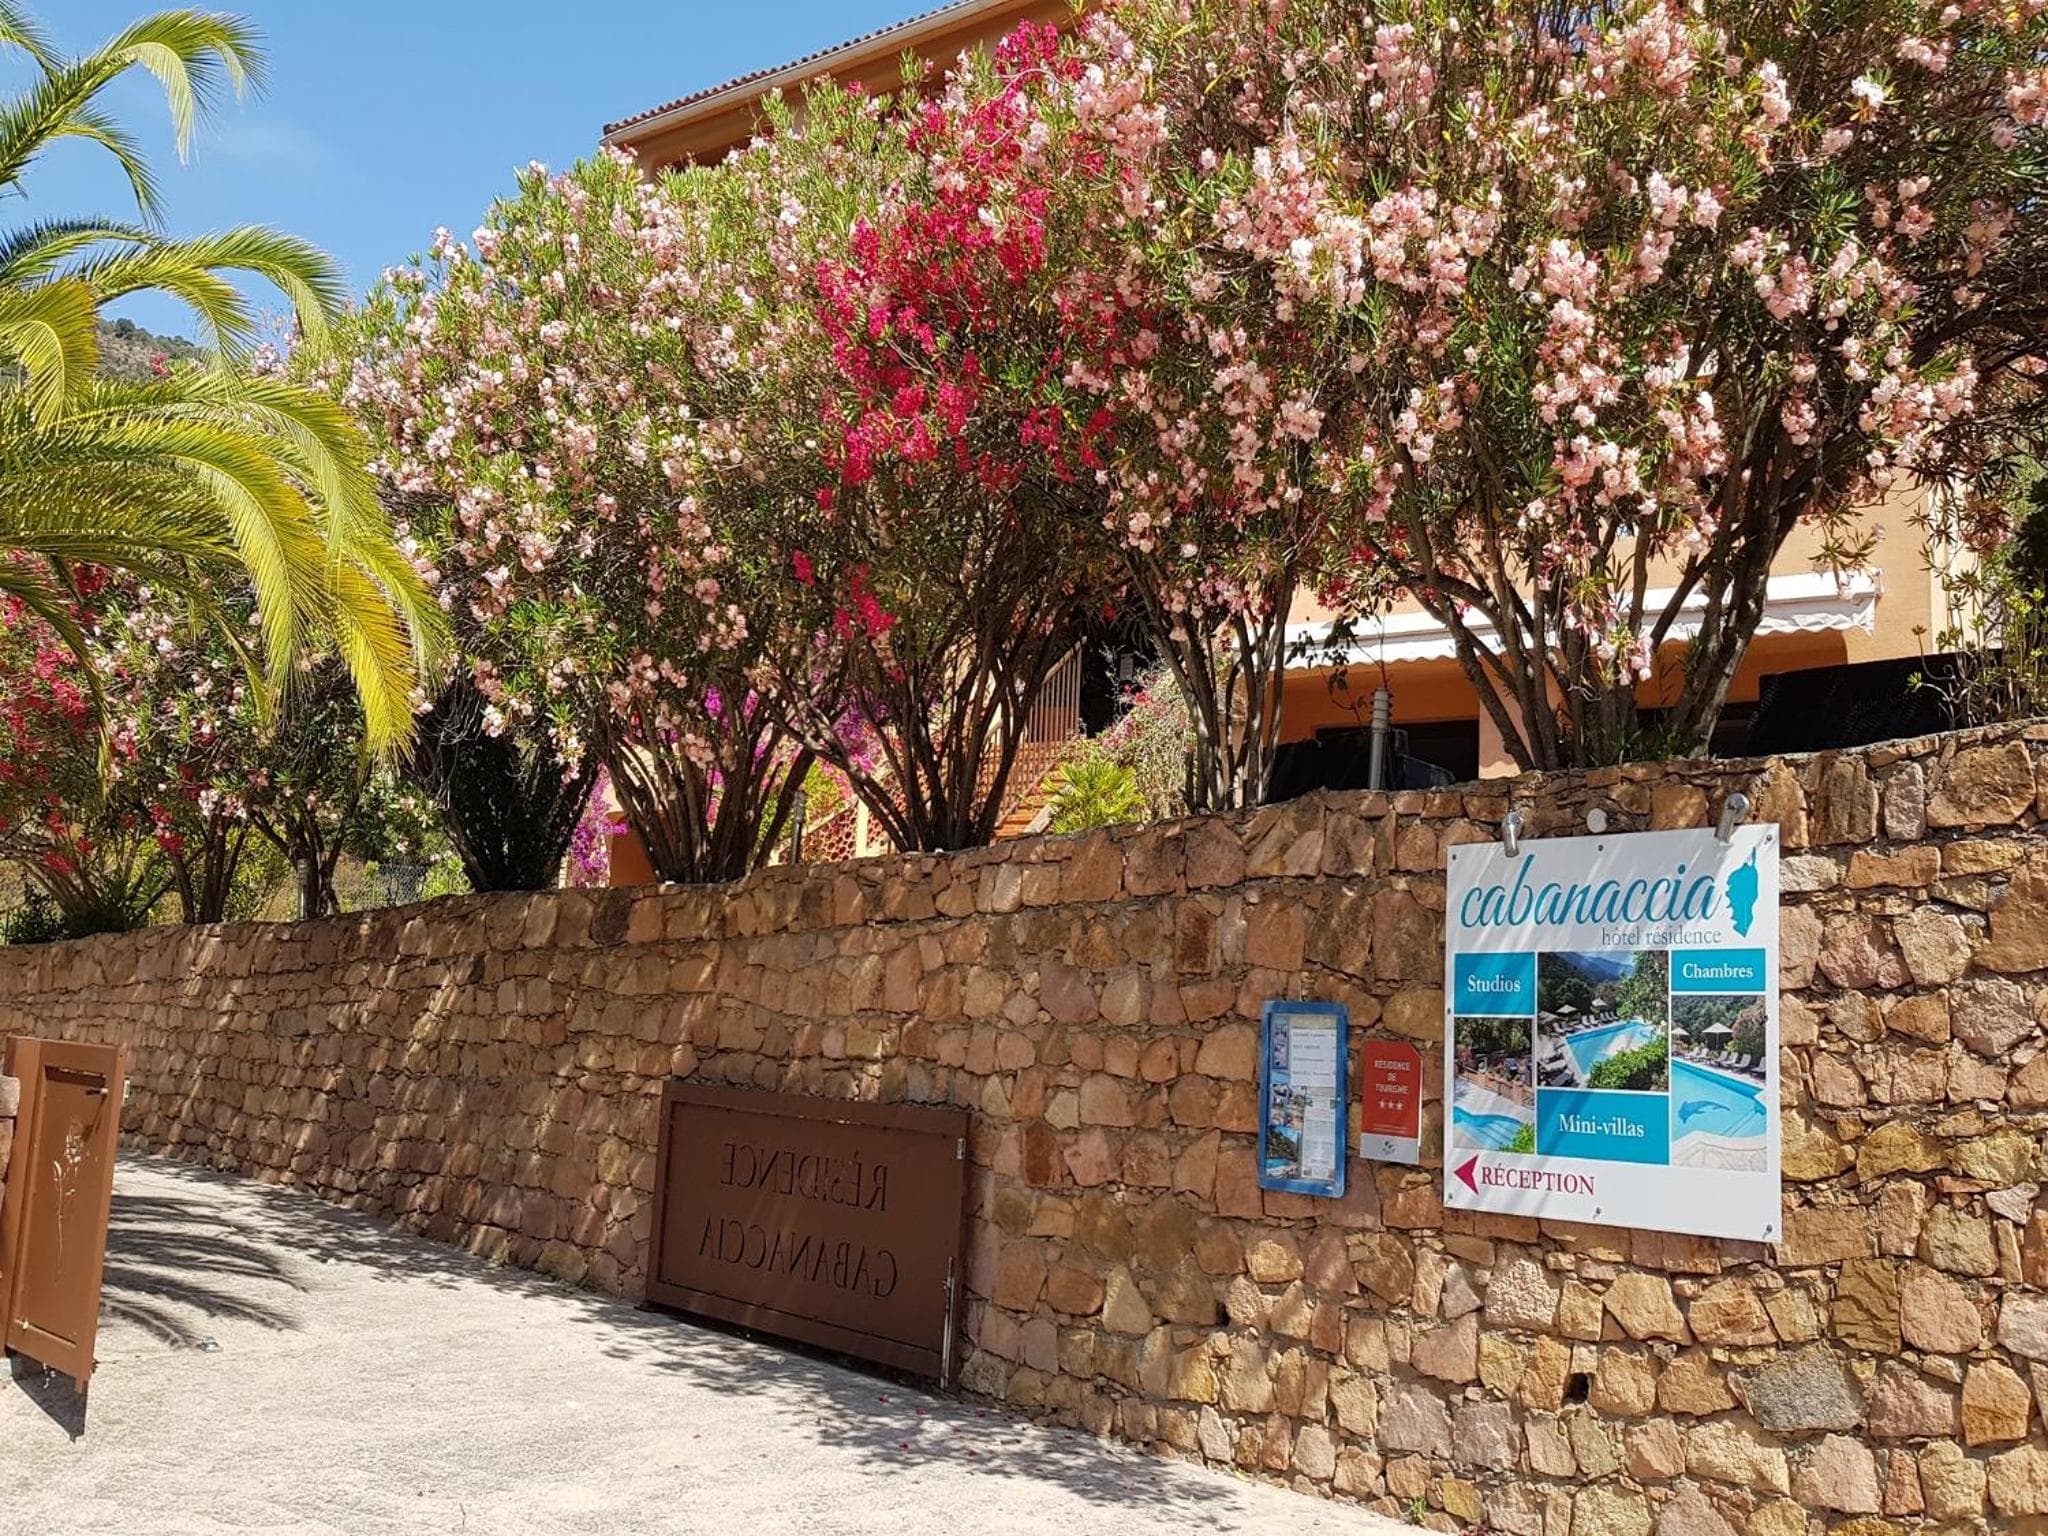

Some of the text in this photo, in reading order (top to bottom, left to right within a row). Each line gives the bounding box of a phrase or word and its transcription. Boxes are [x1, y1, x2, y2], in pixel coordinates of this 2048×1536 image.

[1460, 854, 1722, 929] cabanaccia
[1601, 927, 1722, 946] hôtel résidence
[1682, 962, 1754, 980] Chambres
[1467, 973, 1521, 994] Studios
[1386, 1073, 1397, 1081] DE
[1375, 1083, 1409, 1095] TOURISME
[1558, 1113, 1645, 1139] Mini-villas
[1481, 1162, 1595, 1196] RÉCEPTION
